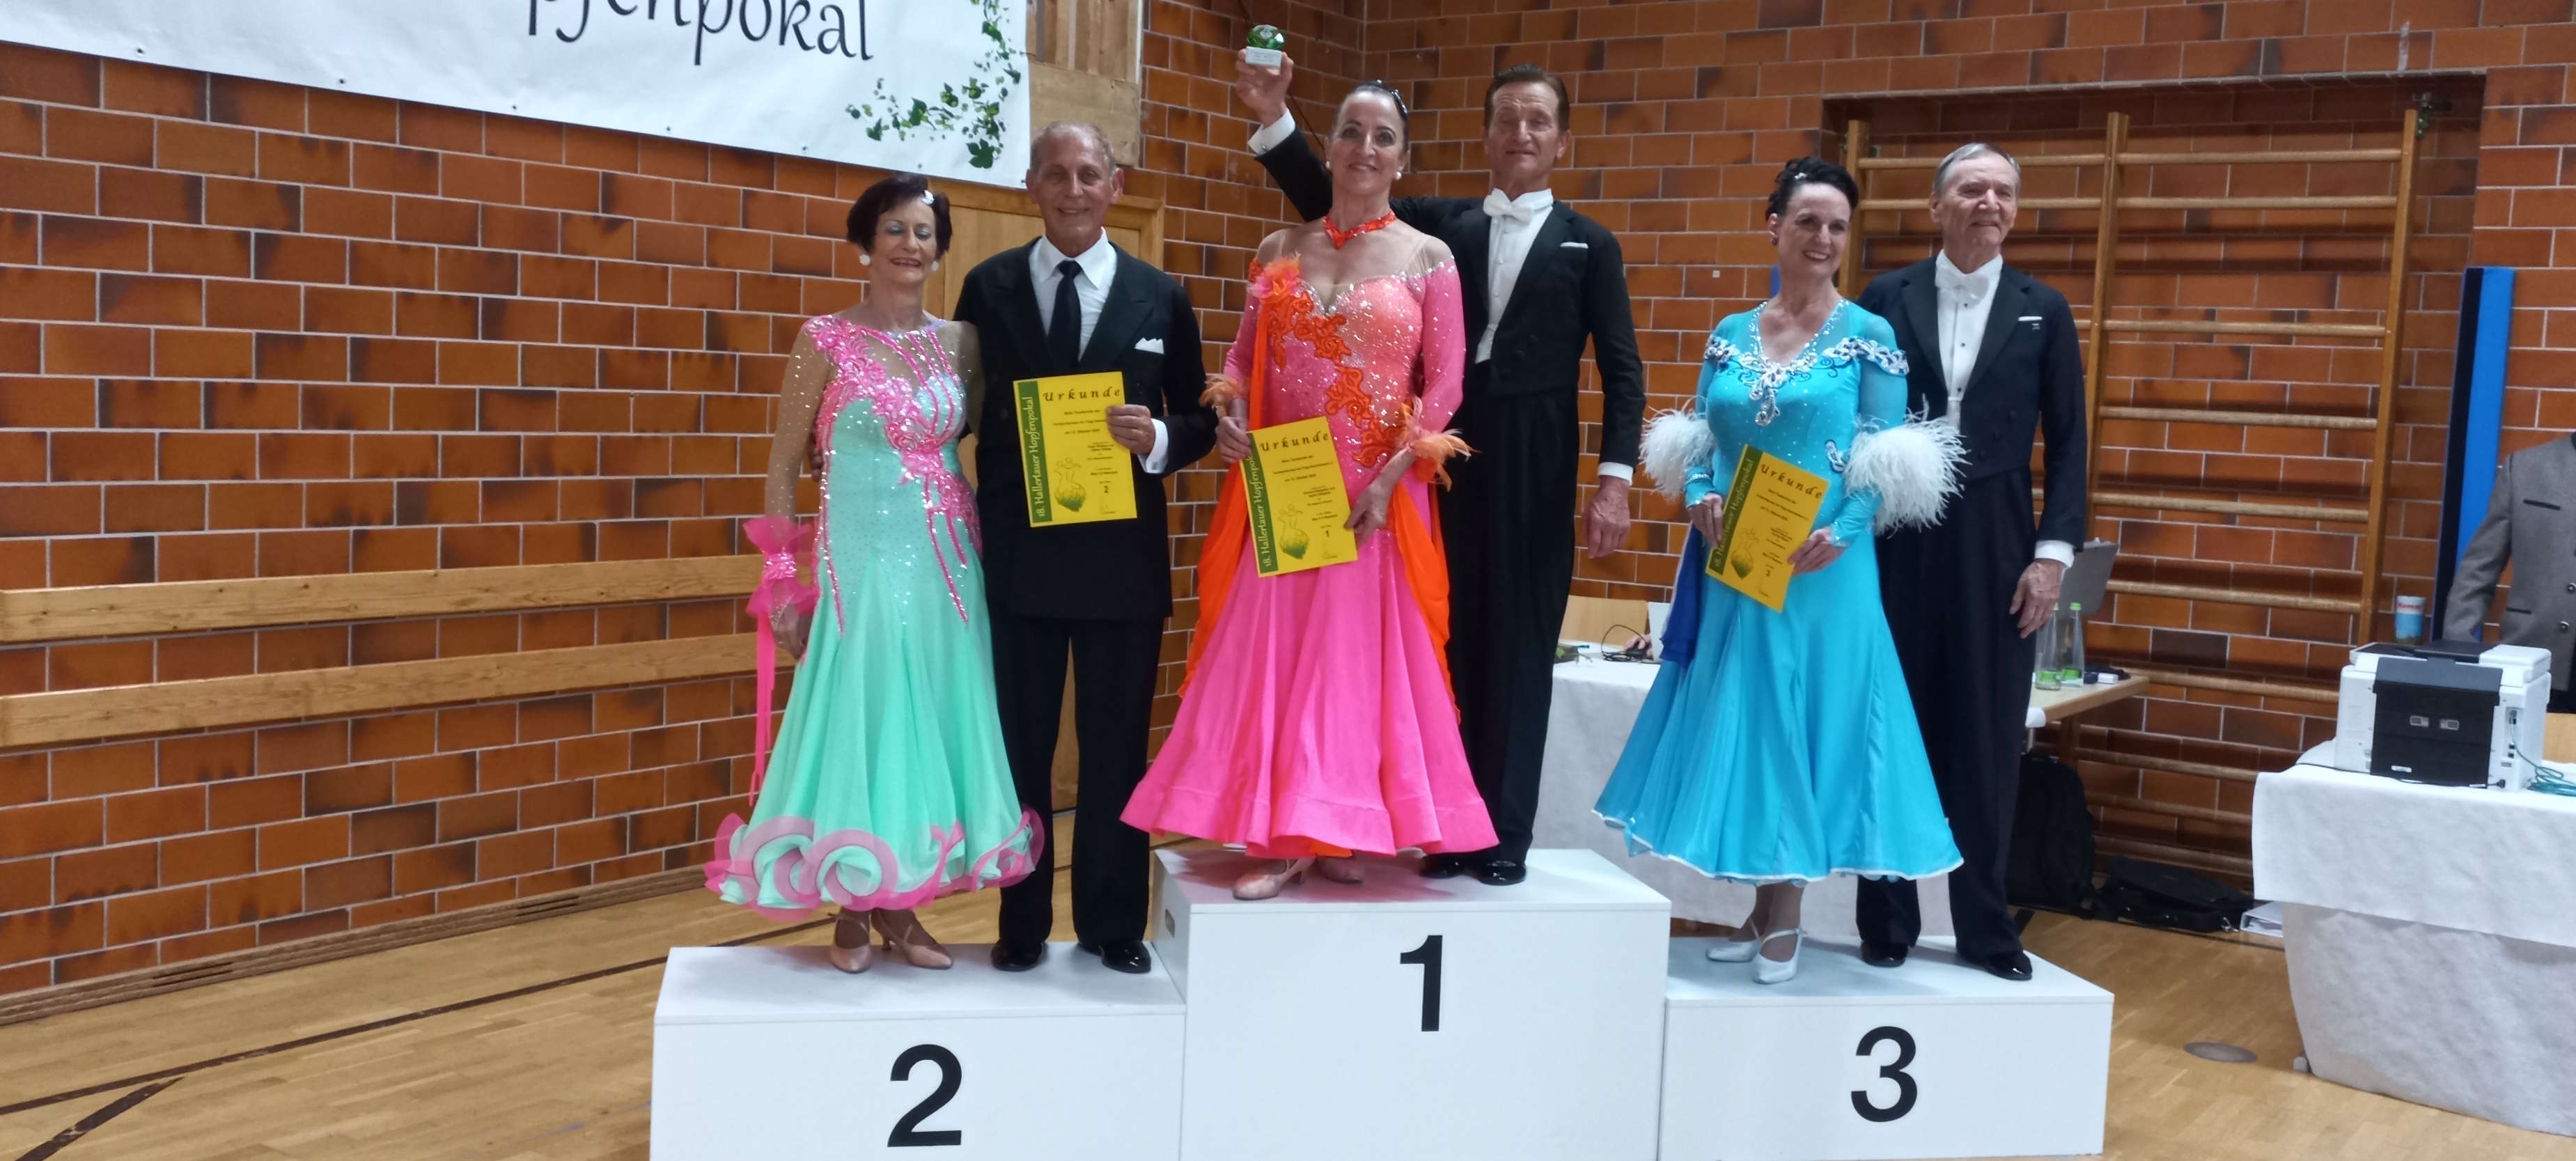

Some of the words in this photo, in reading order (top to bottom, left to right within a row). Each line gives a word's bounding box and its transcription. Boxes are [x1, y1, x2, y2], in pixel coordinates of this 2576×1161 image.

[529, 0, 872, 65] pokal
[1043, 386, 1121, 402] Urkunde
[1022, 396, 1040, 453] Hopfenpokal
[1260, 430, 1330, 452] Urkunde
[1031, 455, 1045, 505] Hallertauer
[1104, 485, 1109, 494] 2
[1245, 455, 1264, 503] Hopfenpok
[1759, 464, 1823, 499] Urkunde
[1257, 505, 1270, 554] Hallertauer
[1400, 935, 1443, 1032] 1
[887, 1044, 962, 1148] 2
[1851, 1026, 1918, 1123] 3
